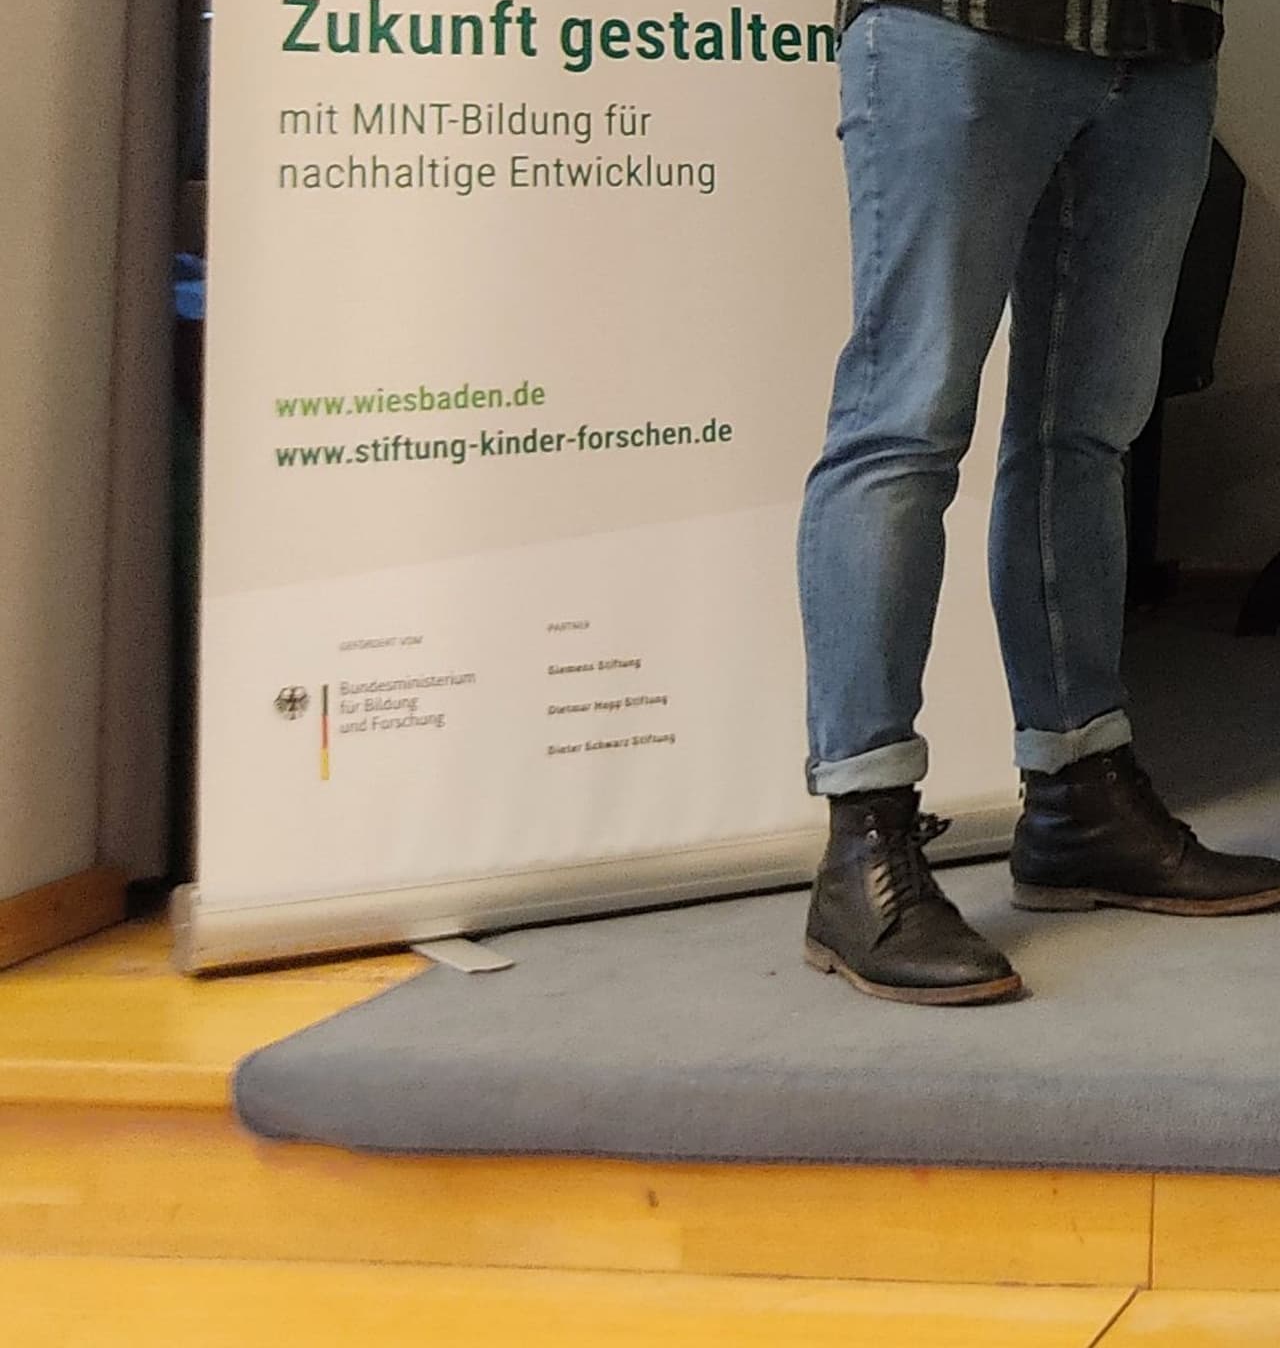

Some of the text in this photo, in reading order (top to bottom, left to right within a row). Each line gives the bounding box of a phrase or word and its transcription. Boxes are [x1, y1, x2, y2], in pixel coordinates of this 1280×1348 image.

[561, 7, 836, 72] gestalten
[279, 102, 652, 143] mit MINT-Bildung für
[279, 155, 717, 196] nachhaltige Entwicklung
[275, 381, 546, 418] www.wiesbaden.de
[275, 419, 733, 467] www.stiftung-kinder-forschen.de
[340, 672, 477, 695] Bundesministerium
[340, 713, 446, 733] und Forschung
[364, 696, 419, 713] Bildung
